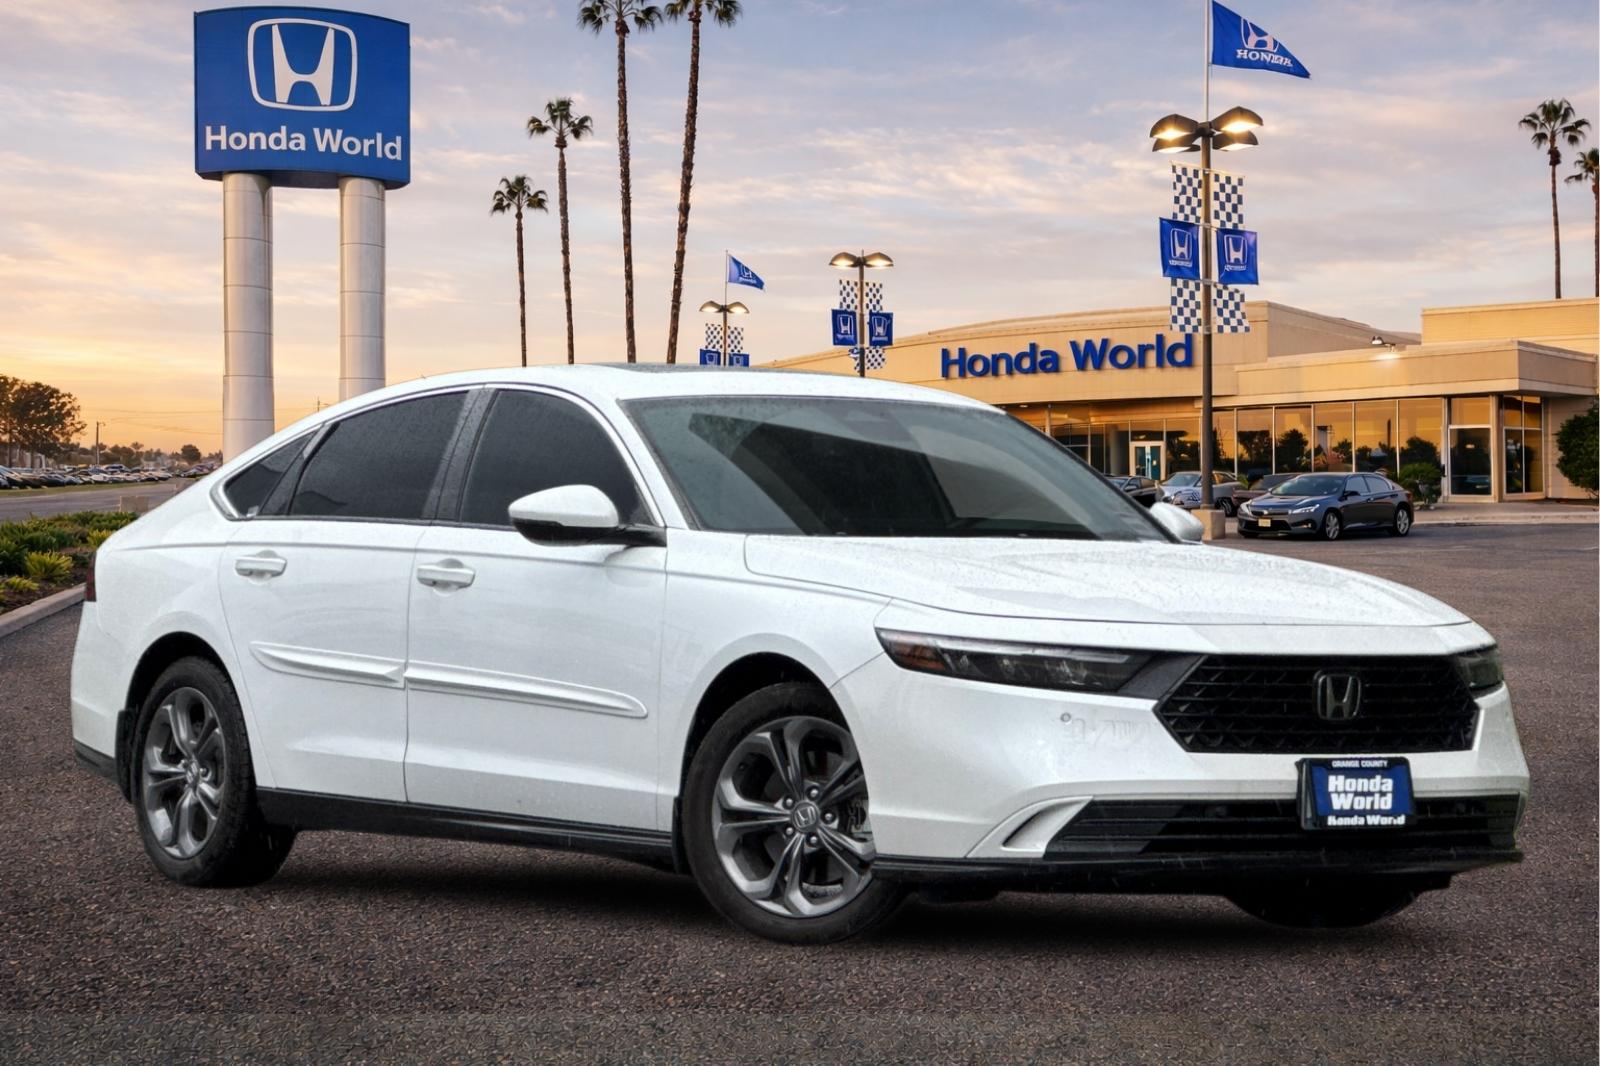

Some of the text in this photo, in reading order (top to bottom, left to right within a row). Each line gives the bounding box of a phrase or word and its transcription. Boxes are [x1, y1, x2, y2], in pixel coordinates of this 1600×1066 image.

[205, 125, 402, 161] Honda World
[941, 333, 1194, 378] Honda World
[1331, 759, 1388, 768] ORANGE COUNTY
[1328, 775, 1393, 792] Honda
[1330, 793, 1393, 810] World
